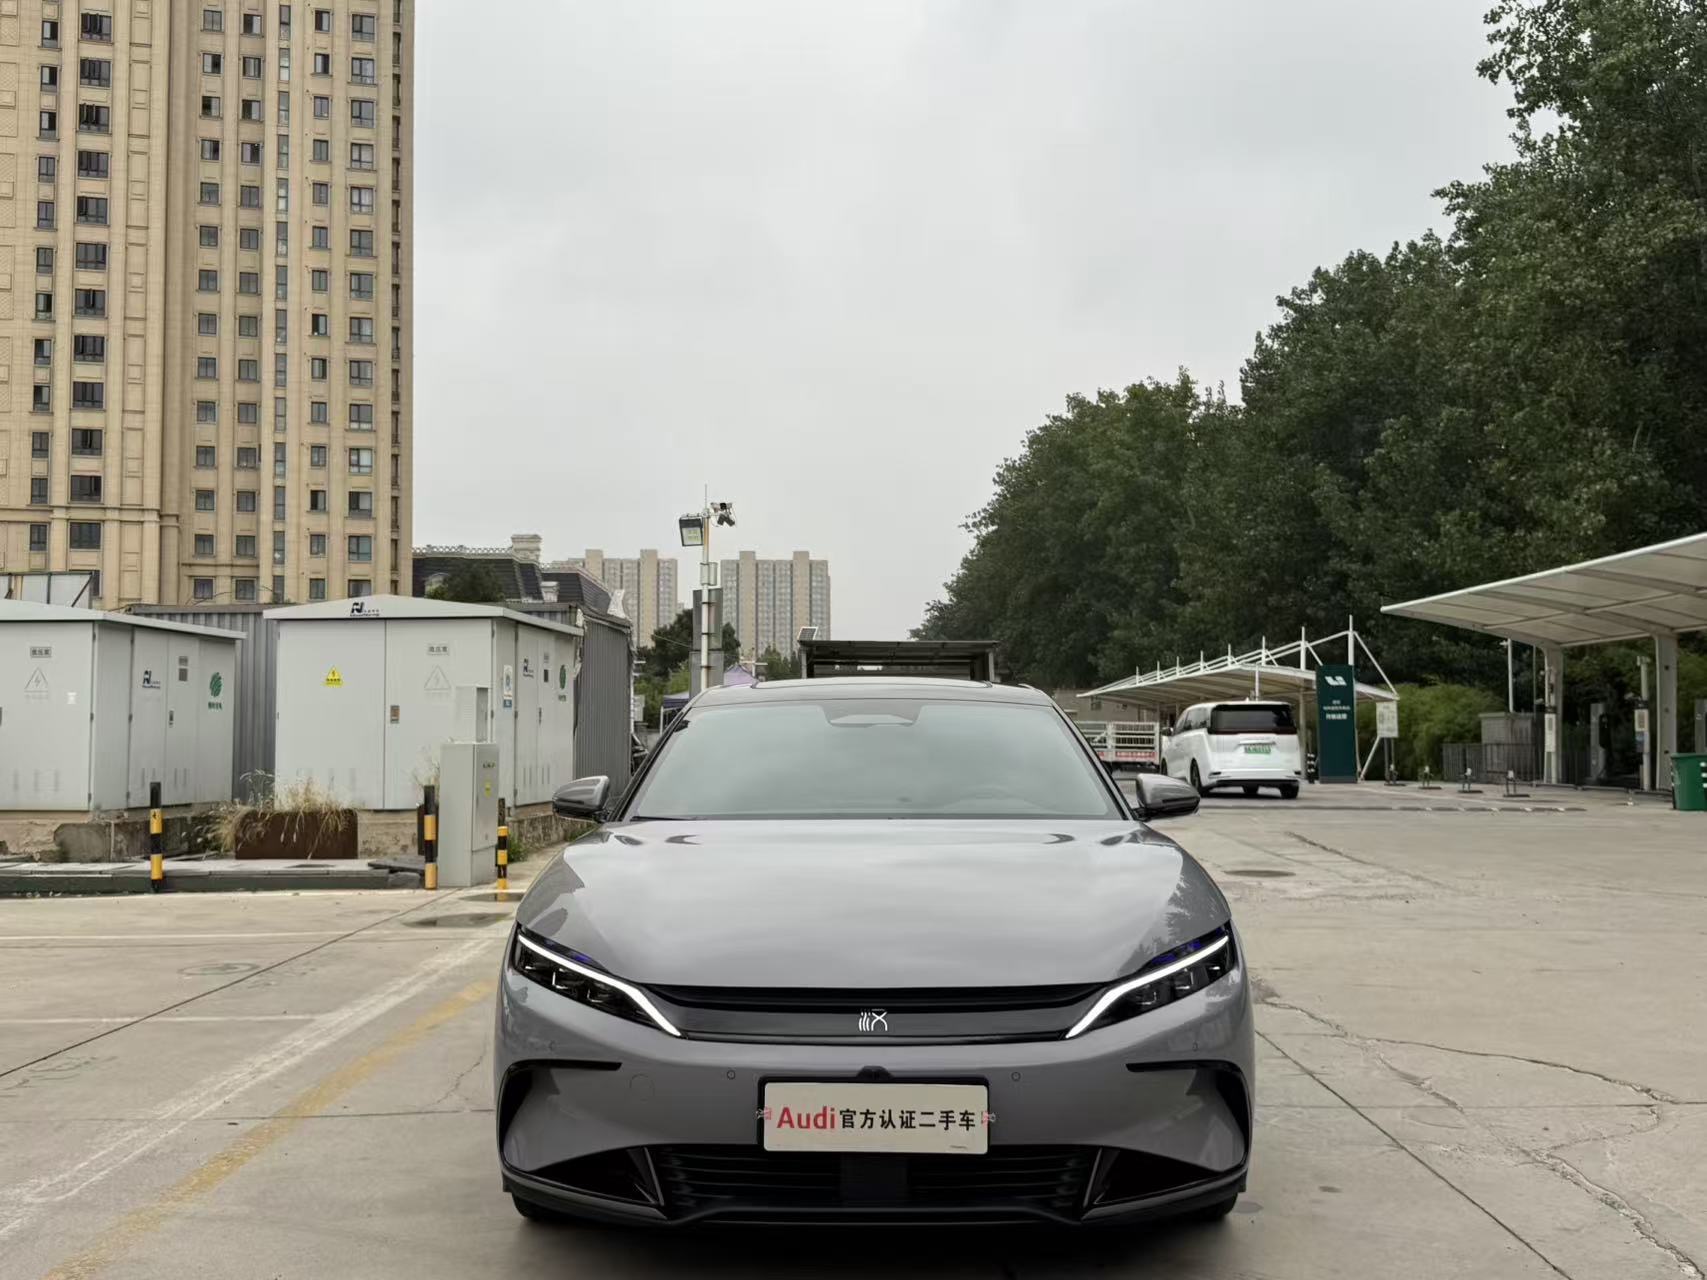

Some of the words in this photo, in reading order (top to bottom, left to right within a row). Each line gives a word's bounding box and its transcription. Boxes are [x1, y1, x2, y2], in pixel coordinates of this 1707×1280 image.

[776, 1105, 835, 1130] Audi
[839, 1108, 976, 1131] 官方认证二手车
